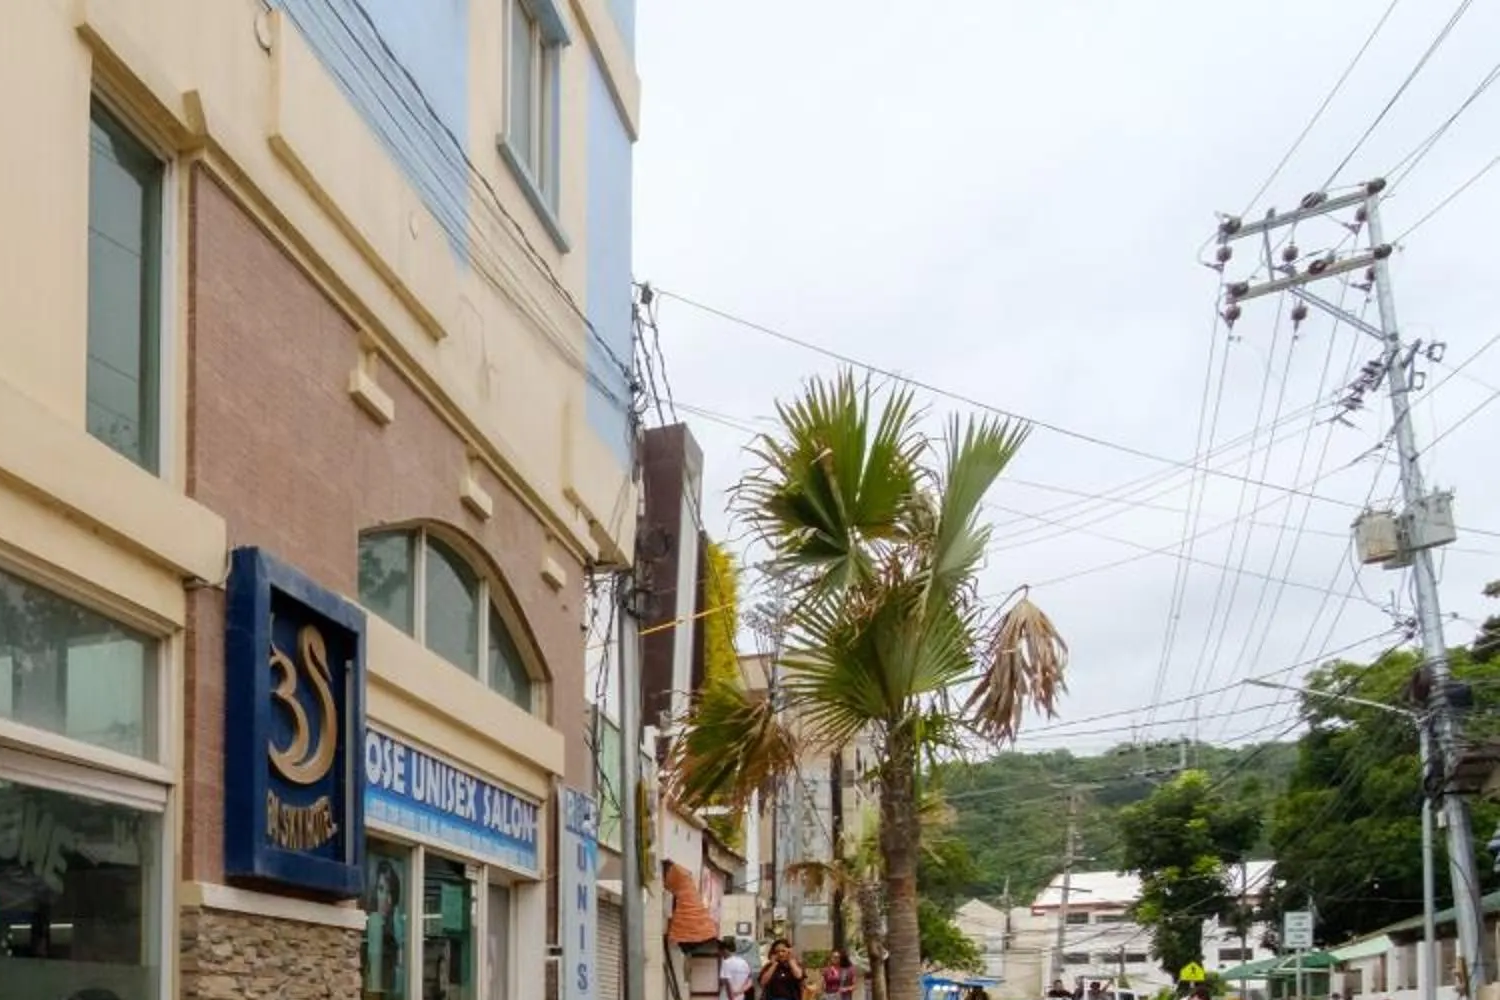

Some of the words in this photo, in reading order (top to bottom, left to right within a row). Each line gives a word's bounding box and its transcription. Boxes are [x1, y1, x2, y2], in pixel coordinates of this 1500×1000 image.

[365, 731, 405, 795] OSE
[411, 751, 477, 822] UNISEX
[483, 785, 534, 843] SALON
